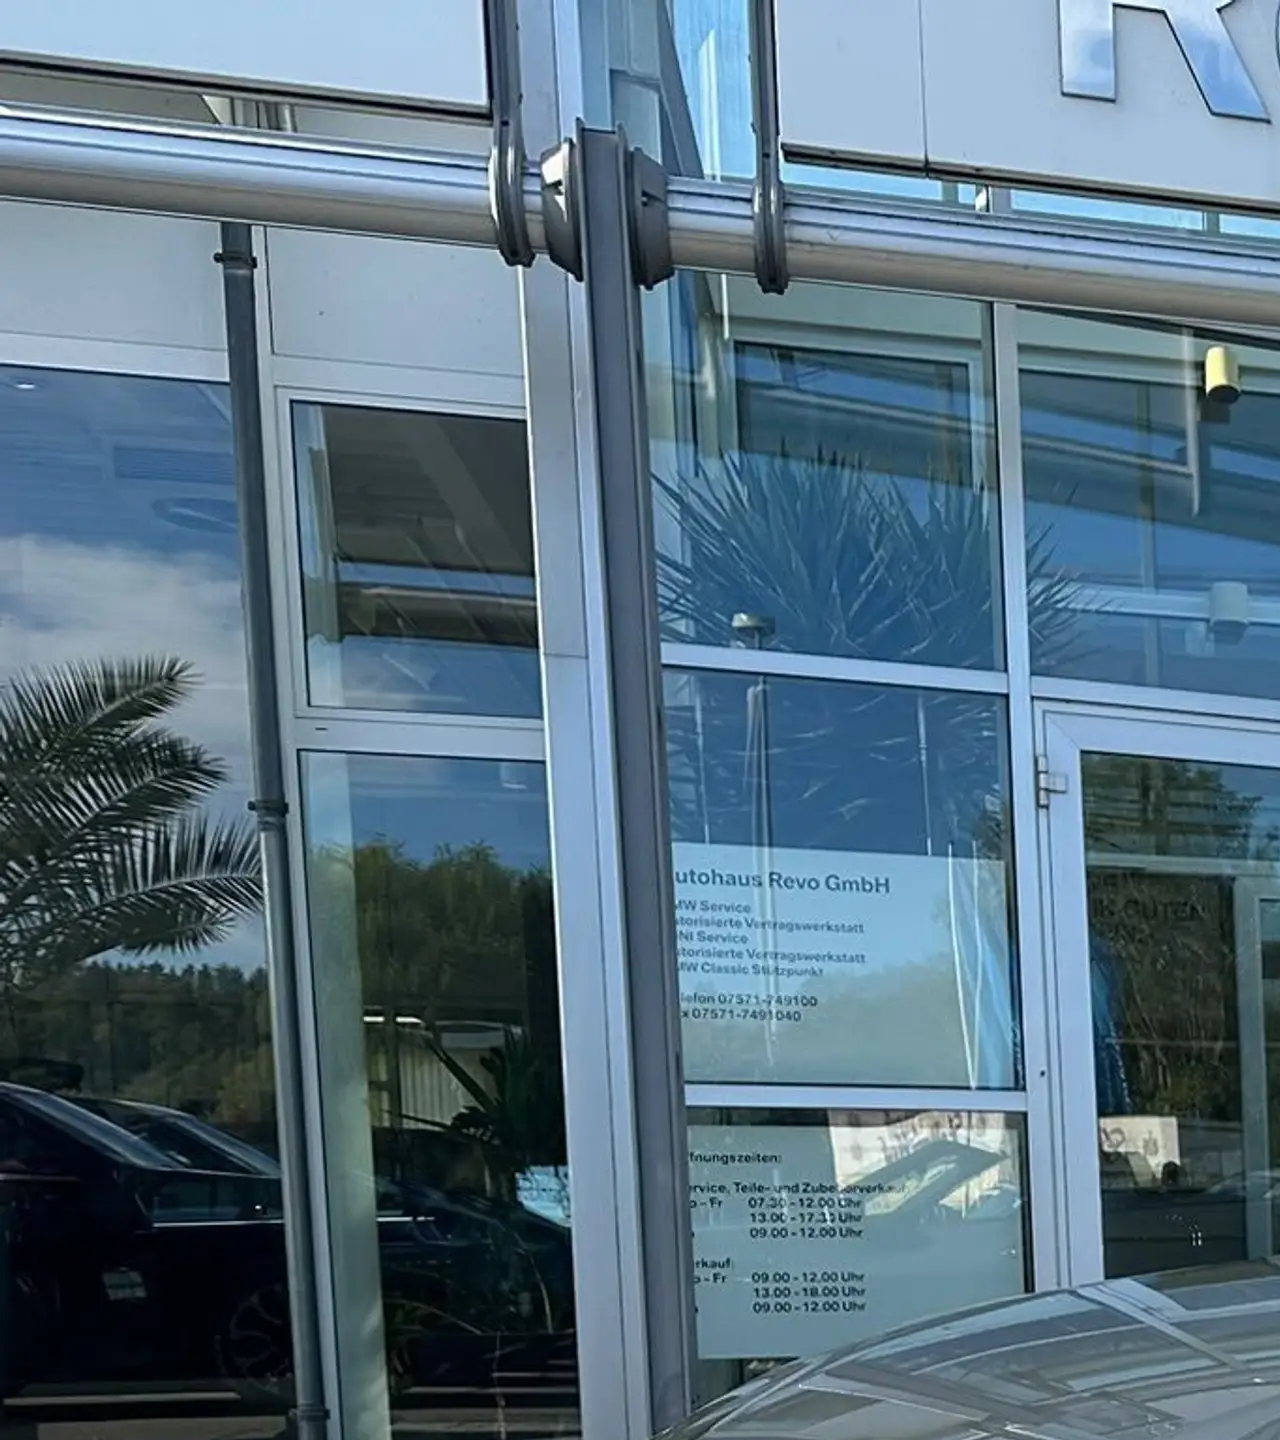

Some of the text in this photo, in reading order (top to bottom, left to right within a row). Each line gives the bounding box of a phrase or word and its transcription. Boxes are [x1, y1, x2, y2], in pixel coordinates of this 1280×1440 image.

[675, 868, 890, 894] utohaus Revo GmbH
[675, 900, 752, 914] MW Service
[676, 916, 864, 934] torisierte Vertragswerkstatt
[678, 930, 748, 944] NI Service
[677, 948, 866, 964] torisierte Vertragswerkstatt
[701, 963, 749, 975] Classic
[718, 993, 818, 1008] 07571-749100
[690, 1152, 782, 1165] fnungszeiten:
[734, 1182, 770, 1193] Teile-
[774, 1182, 800, 1194] und
[709, 1199, 723, 1209] Fr
[838, 1199, 861, 1209] Uhr
[838, 1213, 862, 1223] Uhr
[839, 1227, 864, 1238] Uhr
[713, 1273, 727, 1283] Fr
[841, 1272, 865, 1283] Uhr
[842, 1287, 866, 1298] Uhr
[843, 1302, 867, 1313] Uhr
